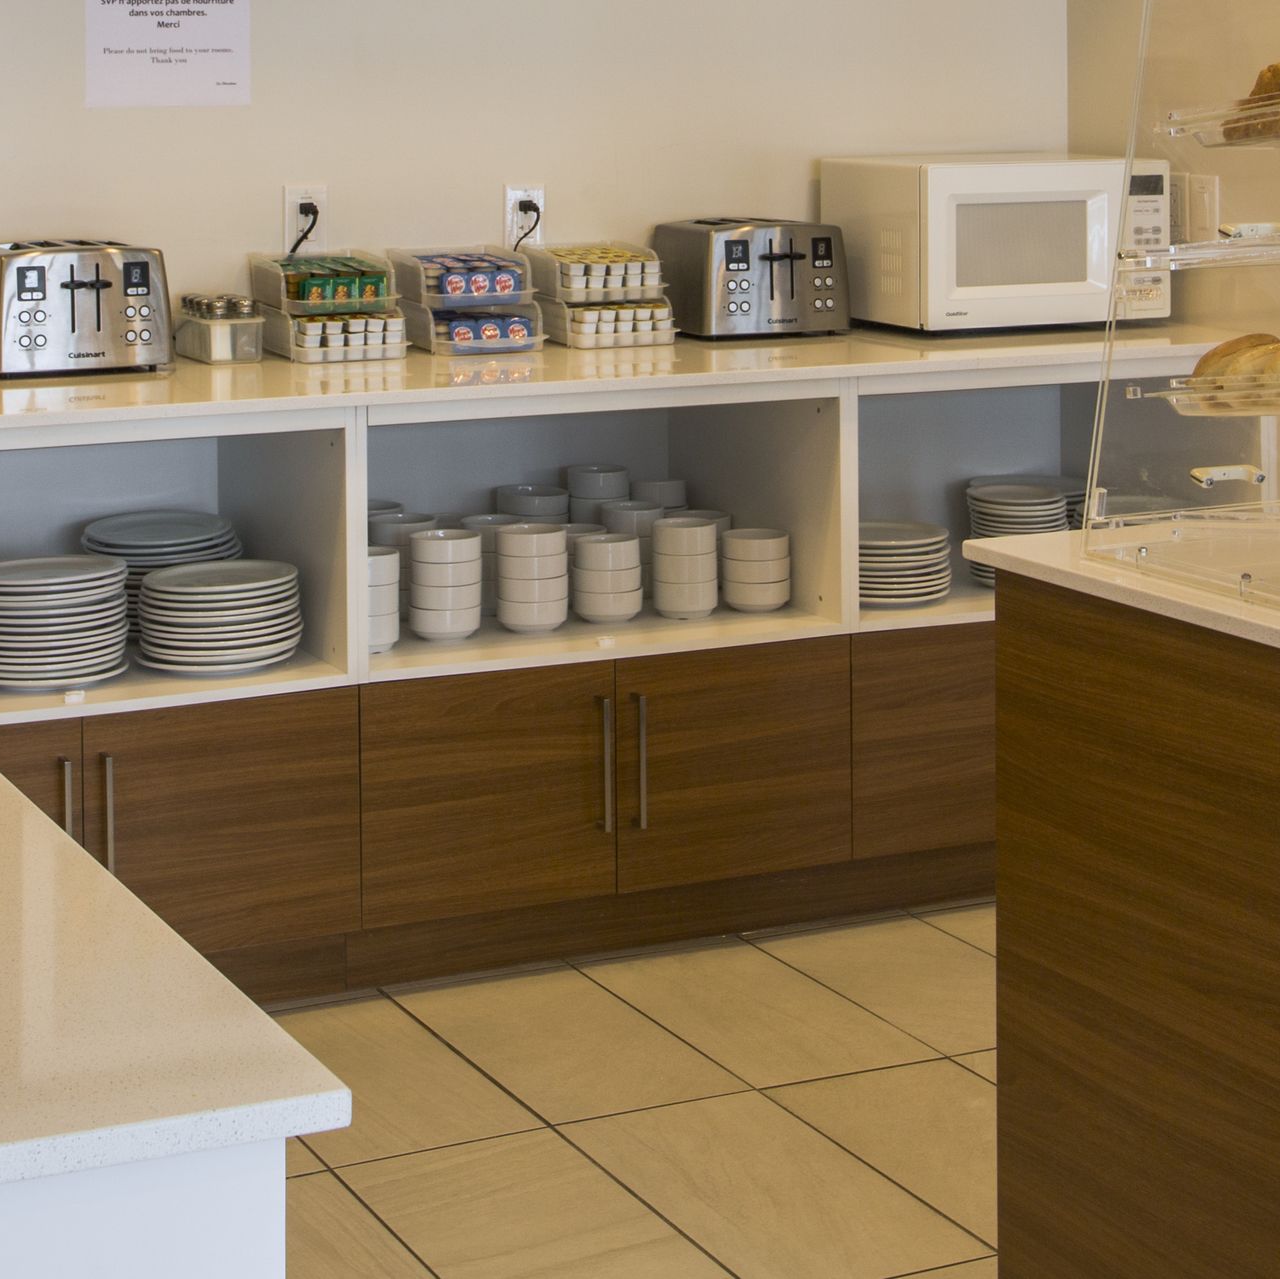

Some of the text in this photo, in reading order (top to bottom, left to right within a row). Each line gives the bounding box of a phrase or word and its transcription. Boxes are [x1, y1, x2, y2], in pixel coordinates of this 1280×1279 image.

[128, 8, 148, 17] dans
[165, 8, 208, 17] chambres.
[156, 21, 180, 29] Merci
[103, 47, 124, 55] Please
[149, 47, 167, 55] bring
[68, 351, 106, 359] Cuisinart
